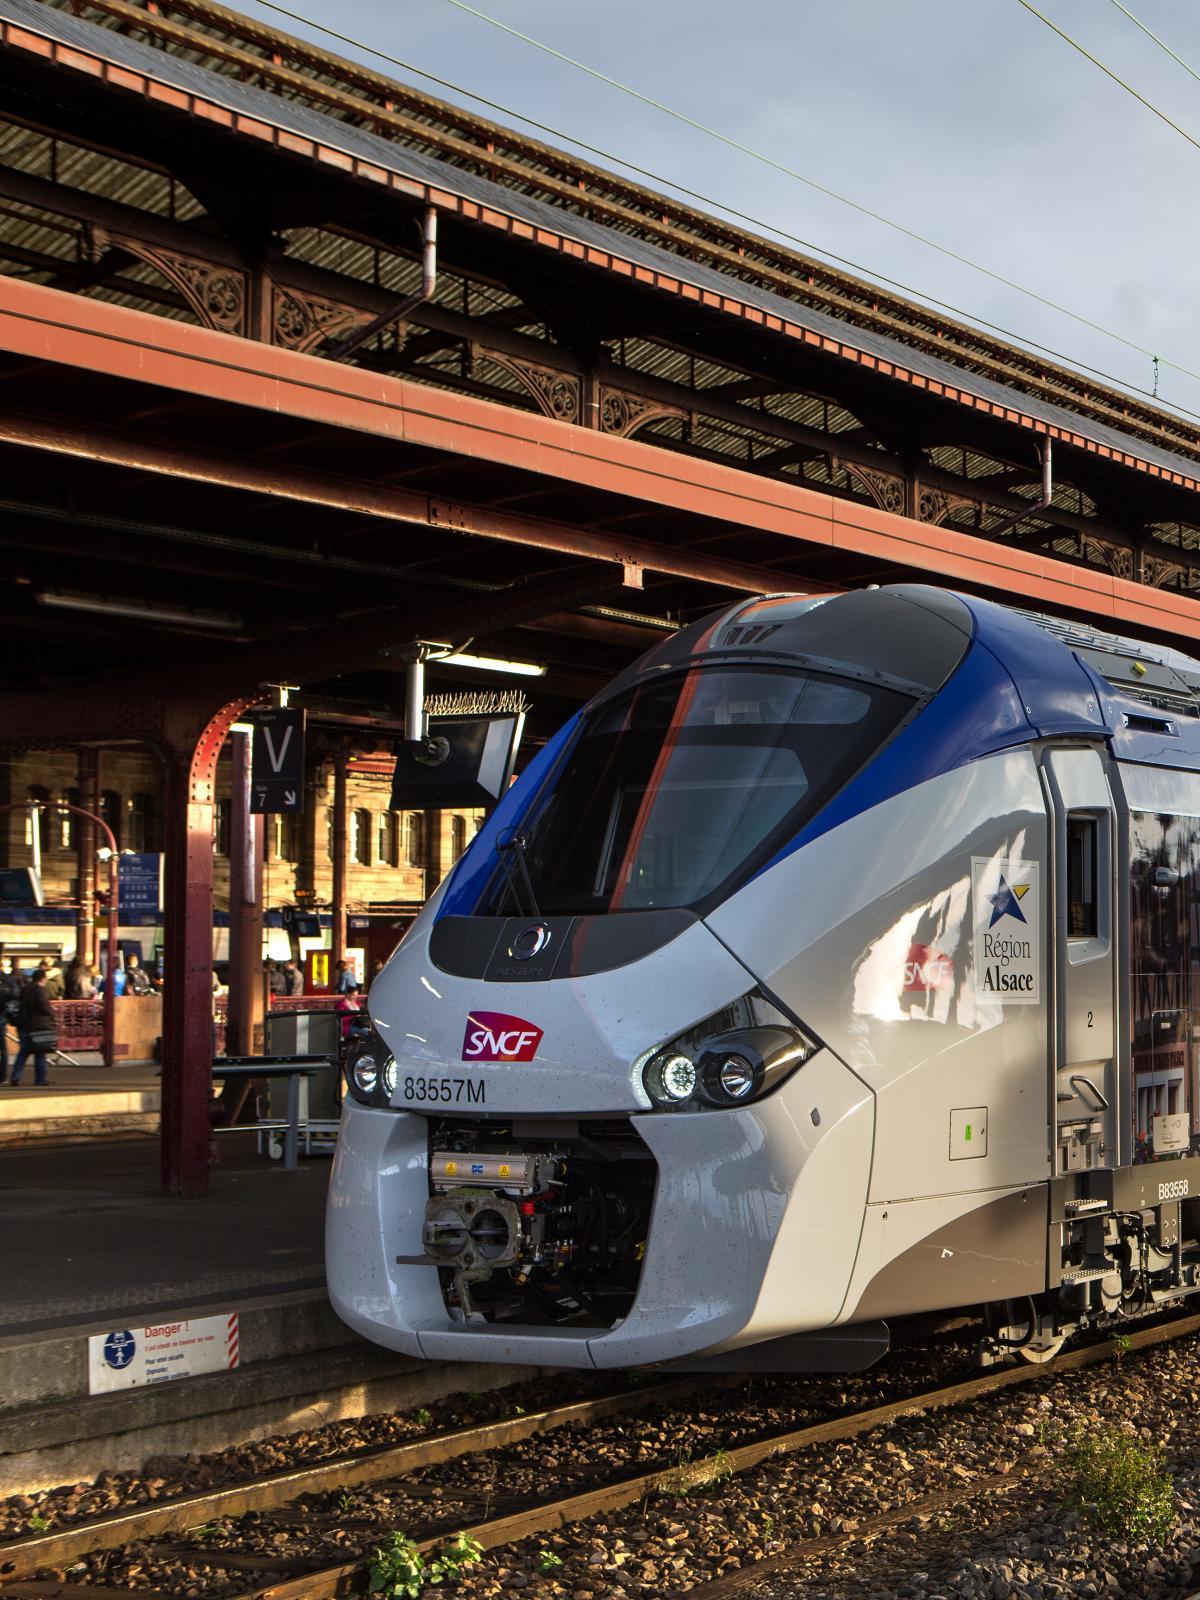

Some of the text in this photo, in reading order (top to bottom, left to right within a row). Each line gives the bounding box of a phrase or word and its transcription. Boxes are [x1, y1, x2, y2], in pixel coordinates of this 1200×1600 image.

[263, 725, 293, 773] V
[258, 793, 266, 807] 7
[983, 932, 1031, 967] Région
[982, 965, 1034, 992] Alsace
[1087, 1011, 1093, 1028] 2
[465, 1031, 537, 1055] SNCF
[404, 1077, 486, 1103] 83557M
[1158, 1179, 1189, 1200] B83558
[144, 1323, 182, 1338] Danger
